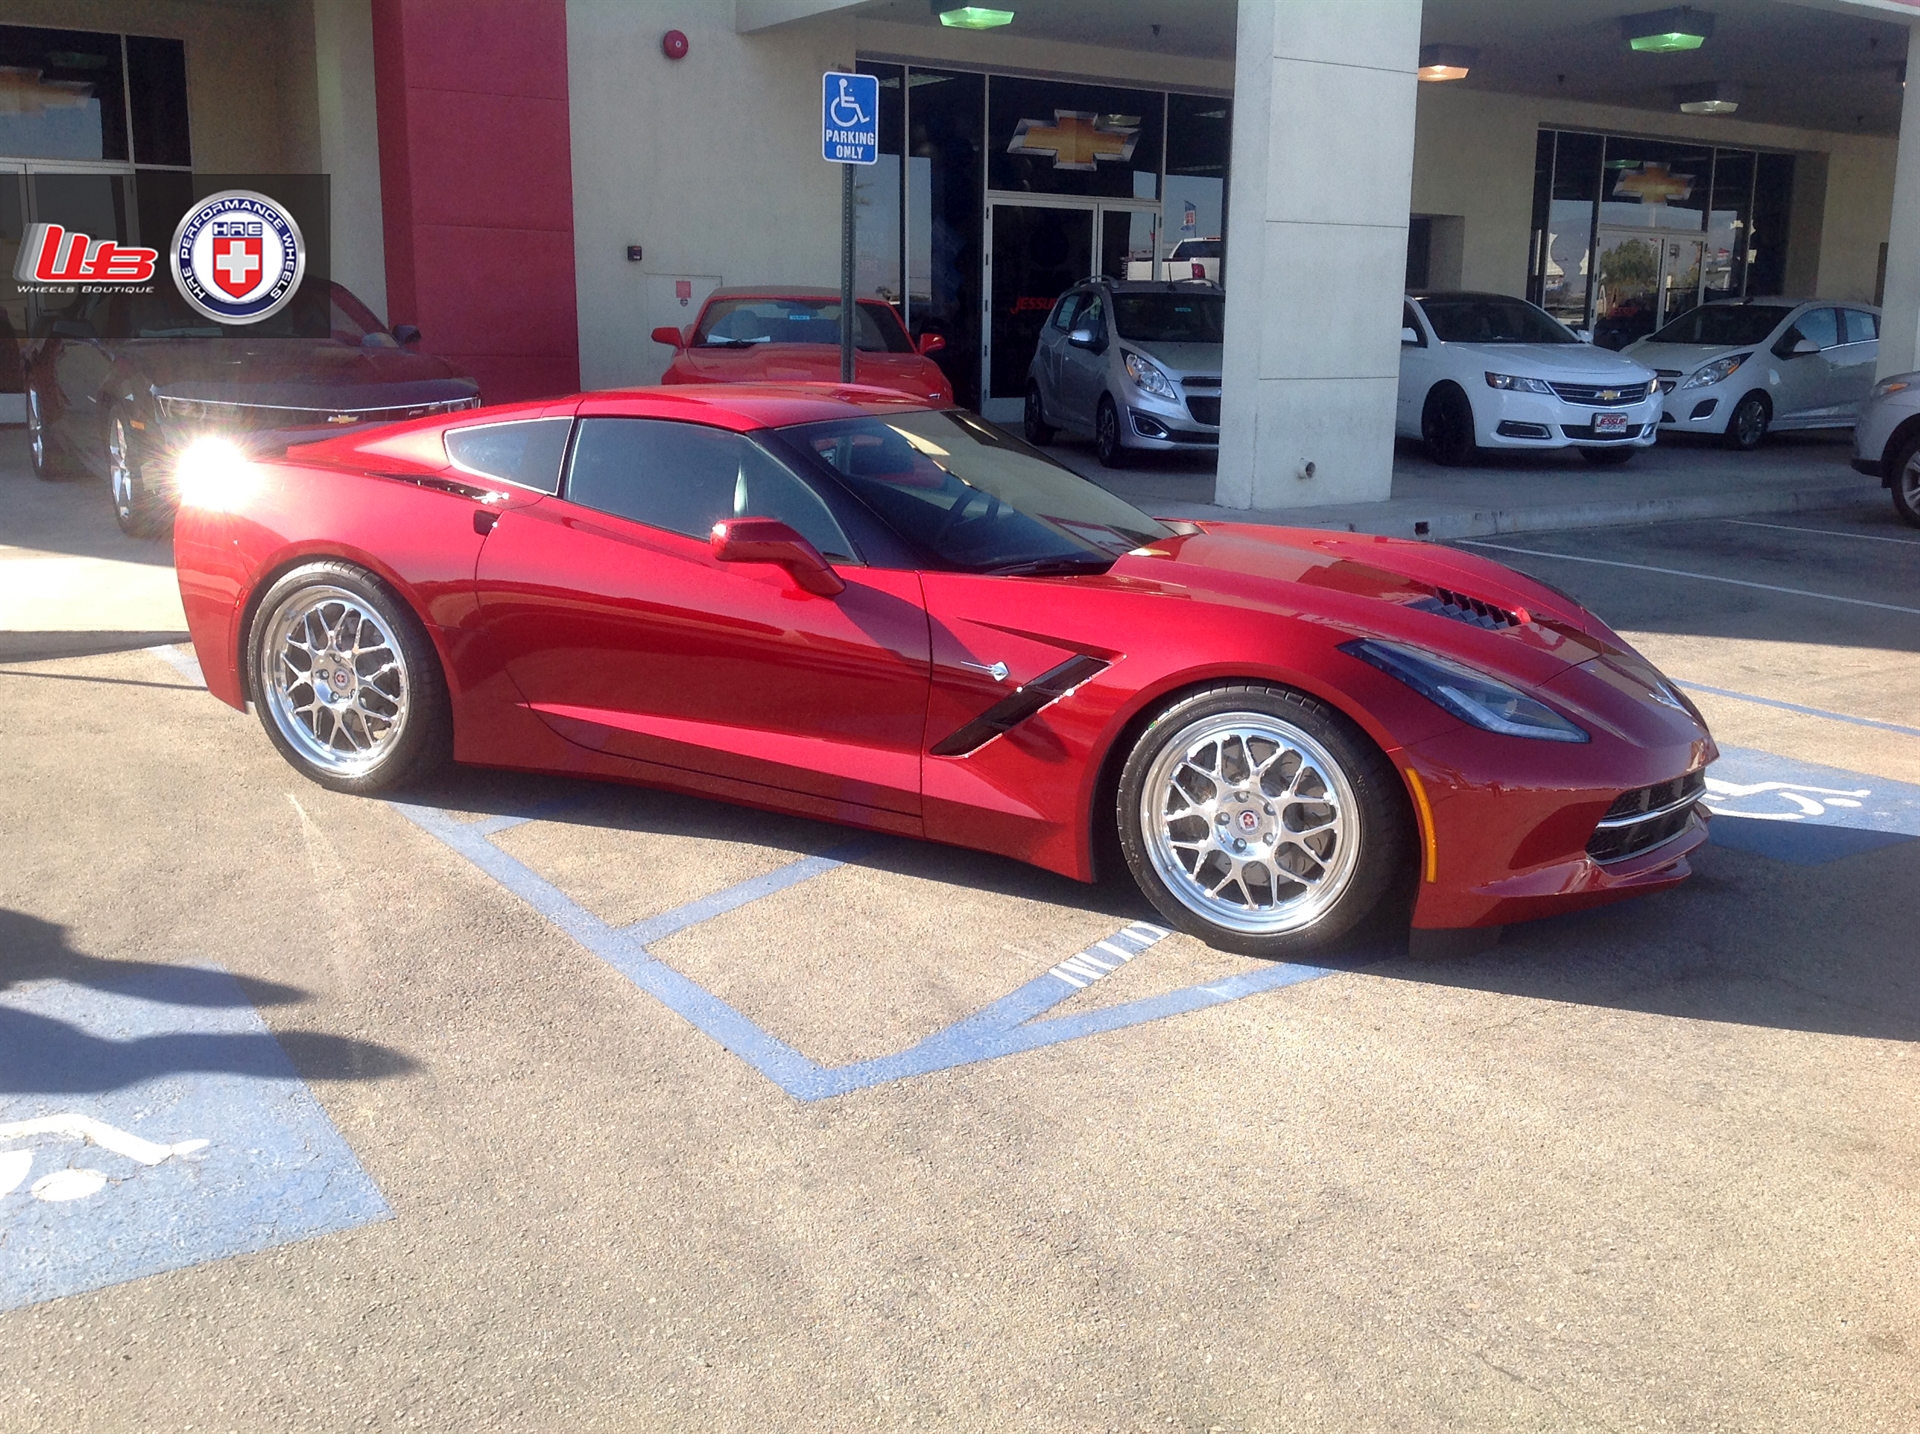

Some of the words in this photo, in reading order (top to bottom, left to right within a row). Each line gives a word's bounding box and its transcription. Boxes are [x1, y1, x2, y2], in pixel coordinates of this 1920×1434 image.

[826, 129, 875, 145] PARKING
[836, 145, 864, 159] ONLY
[1010, 297, 1058, 314] JESSU
